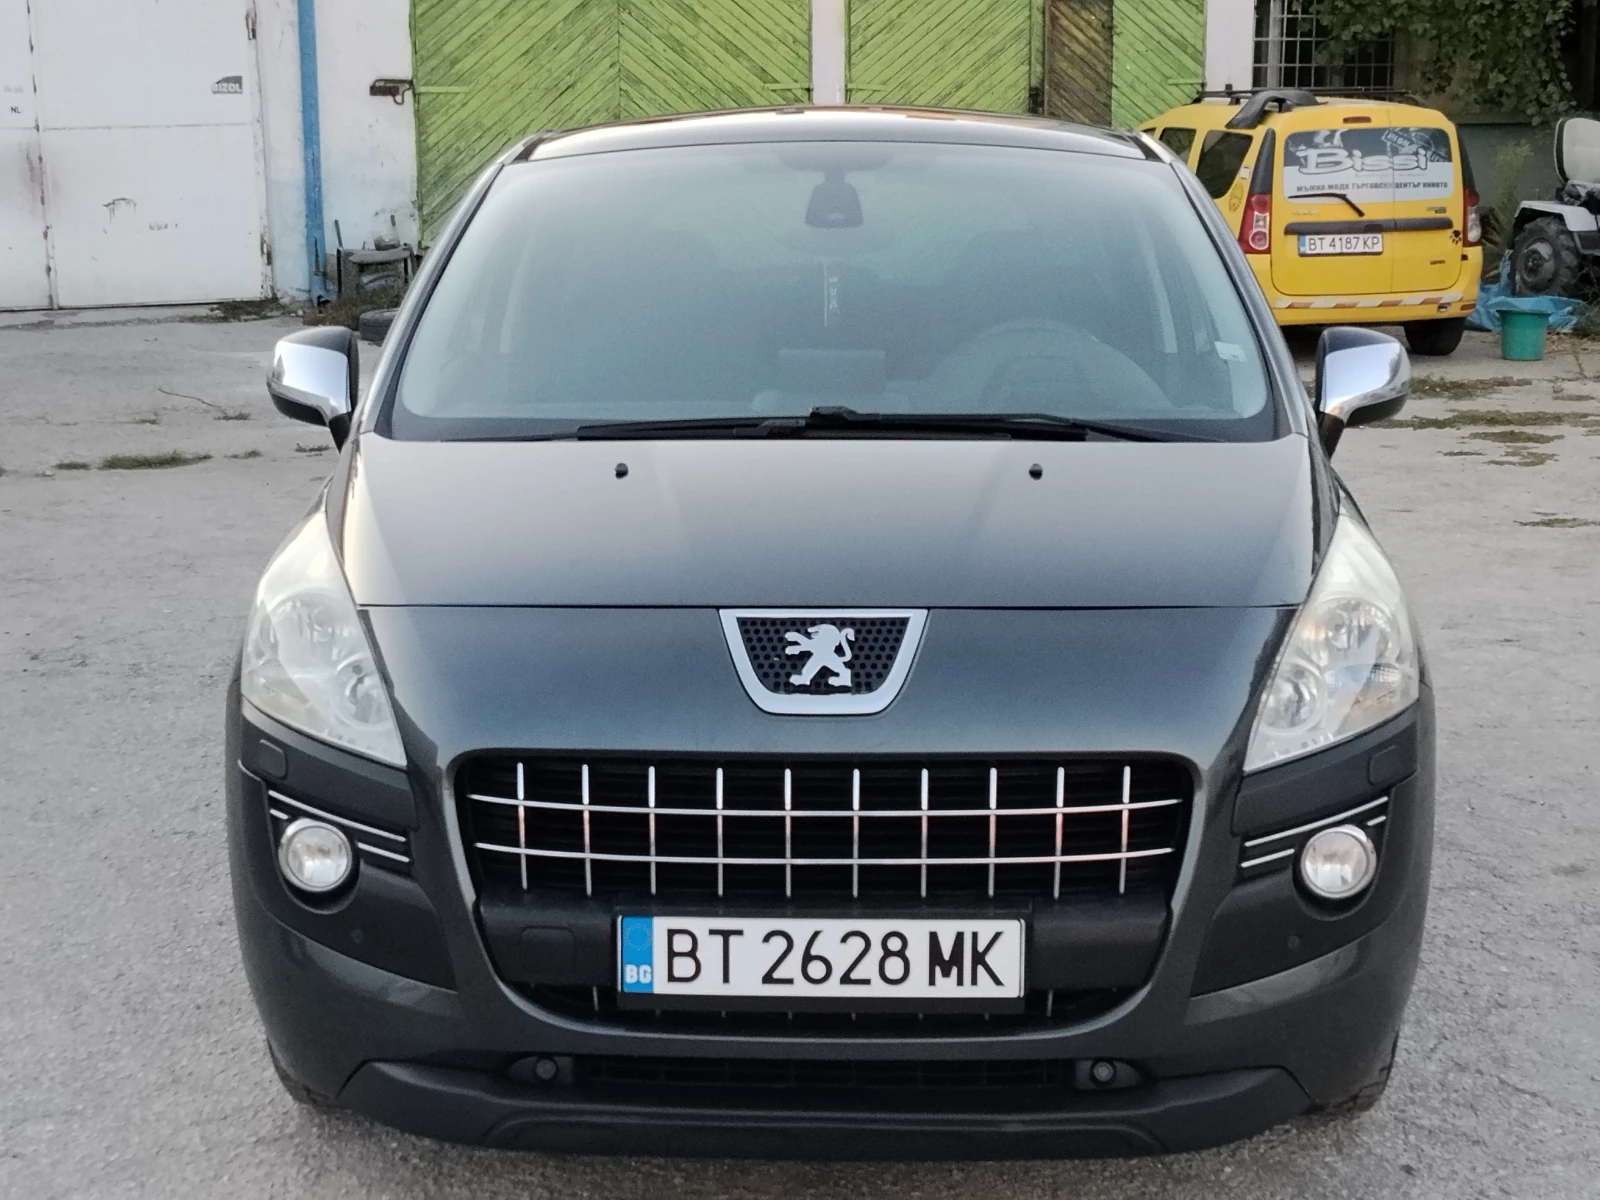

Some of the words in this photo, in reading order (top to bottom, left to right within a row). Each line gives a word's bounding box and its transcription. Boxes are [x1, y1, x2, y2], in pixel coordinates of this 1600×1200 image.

[211, 80, 242, 91] BIZOL
[1295, 145, 1427, 175] Bissi
[1309, 237, 1325, 251] BT
[1329, 236, 1359, 250] 4187
[1364, 236, 1380, 250] KP
[666, 928, 743, 984] BT
[761, 930, 911, 985] 2628
[928, 931, 1005, 986] MK
[626, 964, 652, 984] BG
